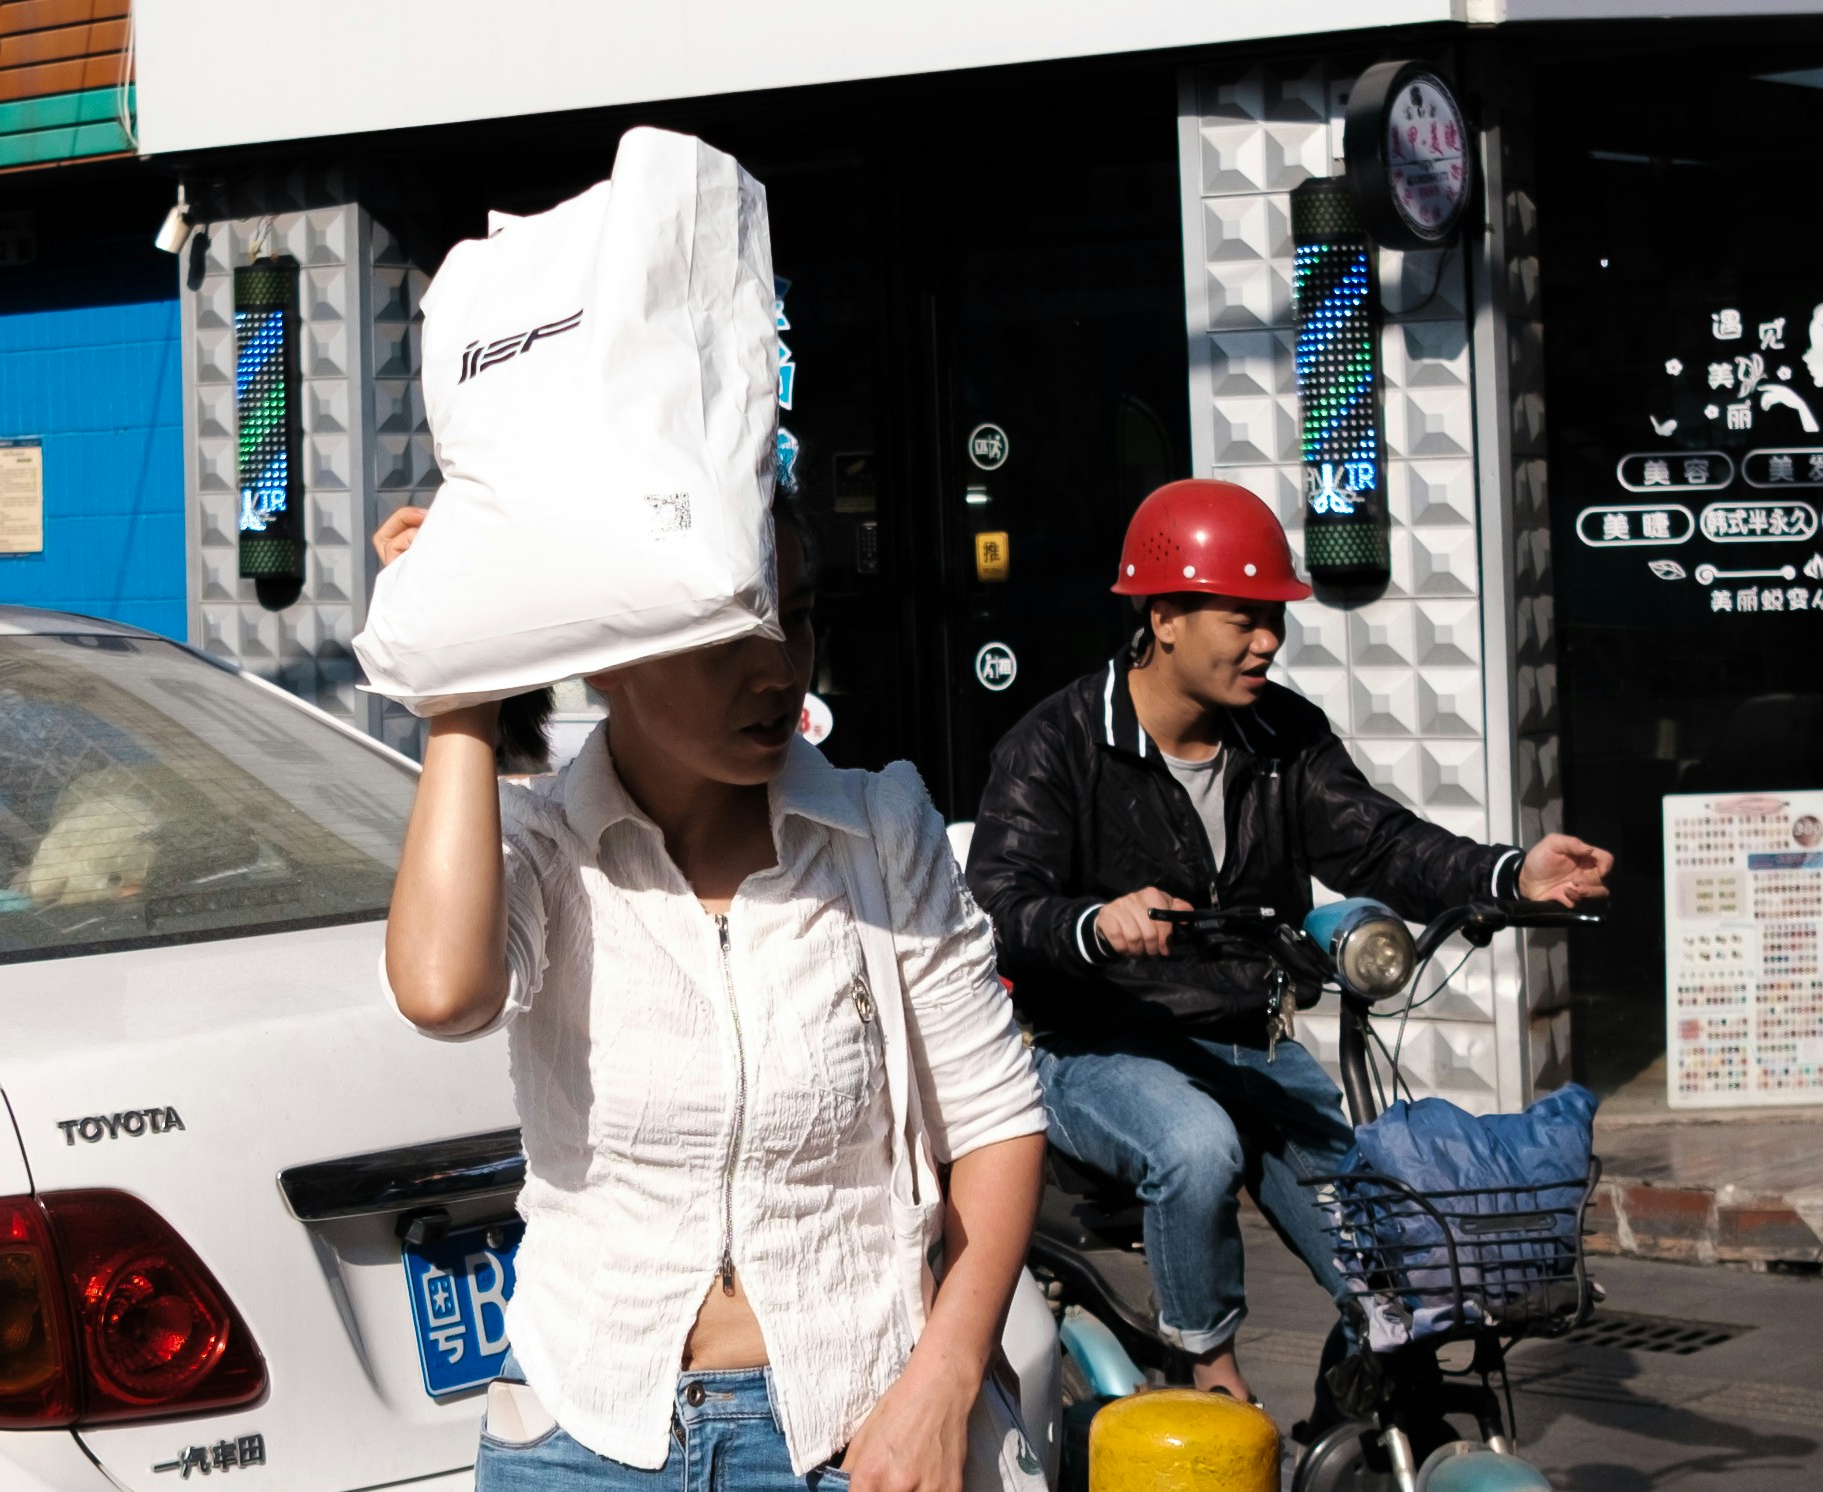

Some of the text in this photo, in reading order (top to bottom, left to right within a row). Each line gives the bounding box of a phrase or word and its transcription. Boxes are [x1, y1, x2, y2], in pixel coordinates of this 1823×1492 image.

[1643, 458, 1711, 487] 美容
[1602, 511, 1671, 540] 美睫
[57, 1106, 187, 1146] TOYOTA
